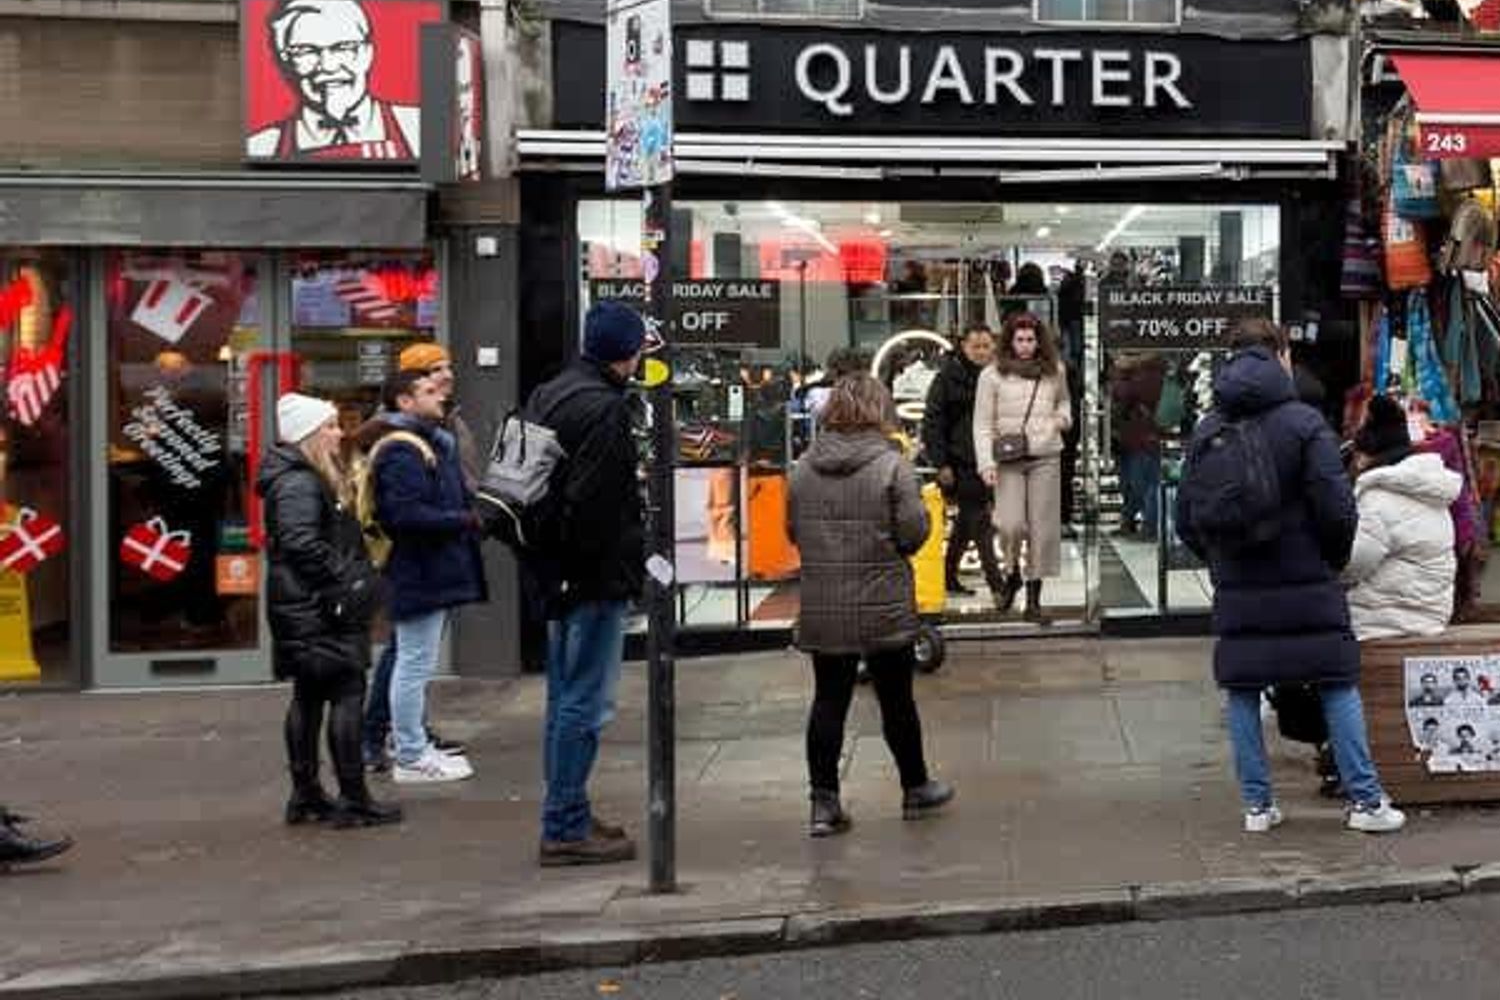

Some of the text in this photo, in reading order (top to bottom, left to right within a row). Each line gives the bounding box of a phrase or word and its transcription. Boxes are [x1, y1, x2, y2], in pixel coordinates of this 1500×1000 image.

[795, 43, 1192, 115] QUARTER
[1427, 132, 1467, 153] 243
[597, 282, 772, 299] BLAC RIDAY SALE
[1109, 291, 1267, 304] BLACK FRIDAY SALE
[682, 312, 730, 331] OFF
[1136, 319, 1180, 337] 70%
[1184, 318, 1228, 337] OFF
